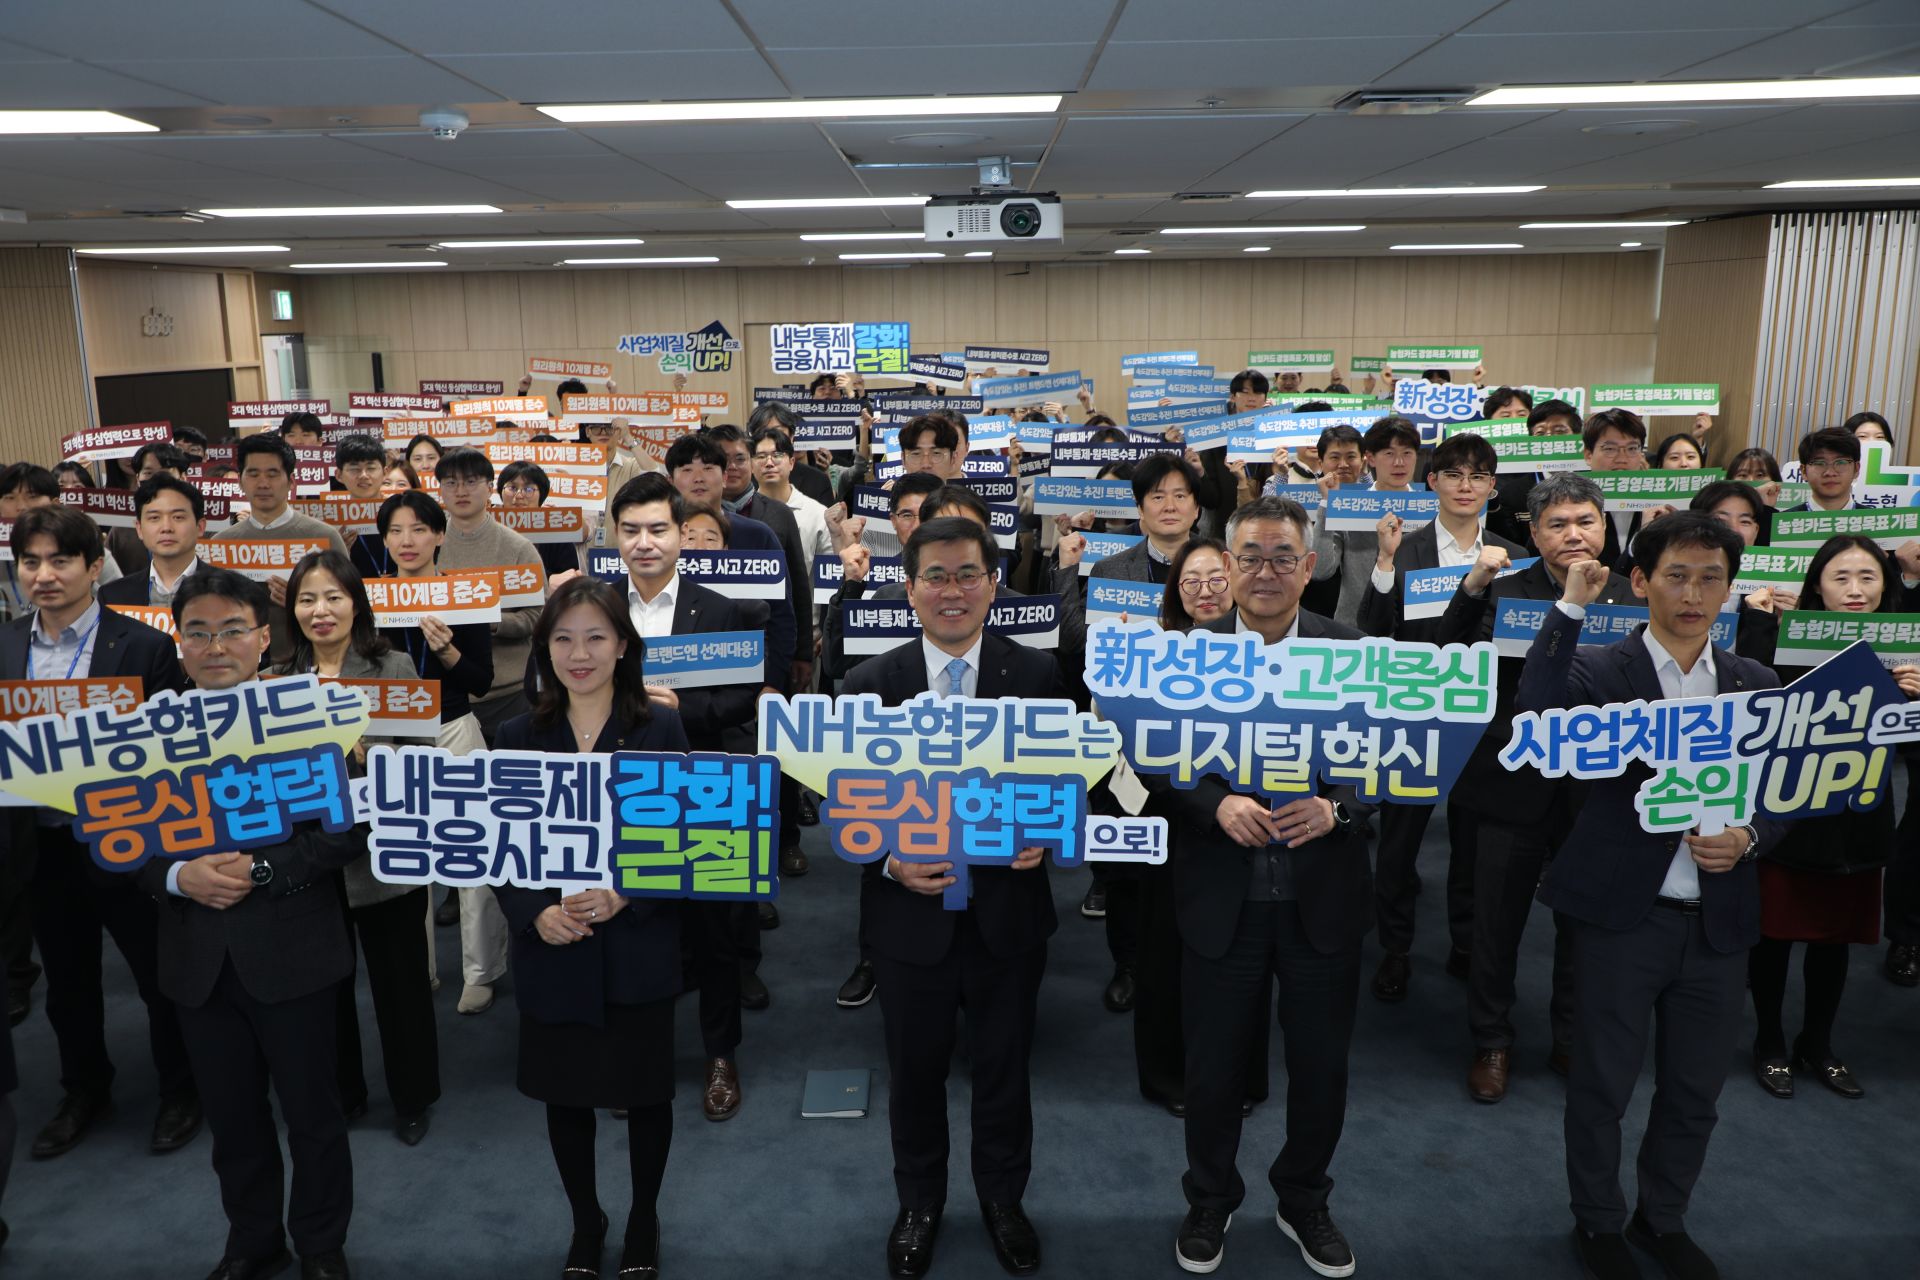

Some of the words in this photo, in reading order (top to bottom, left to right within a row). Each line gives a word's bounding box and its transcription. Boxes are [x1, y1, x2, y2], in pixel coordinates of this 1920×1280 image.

[619, 335, 685, 354] 사업체질
[687, 332, 724, 351] 개선
[773, 327, 850, 349] 내부통제
[855, 324, 908, 349] 강화!
[660, 353, 691, 371] 손익
[694, 351, 730, 371] UP!
[773, 349, 851, 371] 금융사고
[855, 349, 909, 372] 근절!
[1031, 353, 1048, 362] ZERO
[565, 363, 592, 374] 10계명
[592, 364, 609, 376] 준수
[936, 367, 948, 376] 사고
[948, 369, 964, 378] ZERO
[352, 395, 365, 406] 3대
[366, 396, 381, 407] 혁신
[382, 397, 422, 408] 동심협력으로
[423, 398, 440, 408] 완성!
[708, 394, 726, 405] 준수
[1594, 389, 1634, 402] 농협카드
[1634, 388, 1674, 401] 경영목표
[1693, 388, 1715, 401] 달성!
[231, 405, 245, 416] 3대
[246, 404, 261, 416] 혁신
[262, 403, 308, 416] 동심협력으로
[308, 403, 327, 413] 완성!
[454, 400, 492, 416] 원리원칙
[492, 399, 524, 412] 10계명
[525, 398, 545, 411] 준수
[567, 397, 610, 411] 원리원칙
[612, 397, 648, 412] 10계명
[649, 398, 671, 412] 준수
[826, 404, 840, 413] 사고
[841, 403, 862, 413] ZERO
[882, 400, 946, 410] 내부통제·원칙준수로
[946, 400, 961, 410] 사고
[961, 400, 981, 410] ZERO
[678, 408, 698, 420] 준수
[387, 421, 429, 436] 원리원칙
[429, 419, 468, 435] 10계명
[469, 419, 493, 434] 준수
[816, 426, 832, 436] 사고
[832, 425, 853, 436] ZERO
[1020, 427, 1053, 439] 속도감있는
[1187, 424, 1221, 438] 속도감있는
[1221, 420, 1237, 431] 추진!
[1258, 418, 1298, 434] 속도감있는
[1299, 417, 1318, 430] 추진!
[84, 427, 142, 449] 동심협력으로
[143, 426, 168, 441] 완성!
[489, 444, 536, 462] 원리원칙
[537, 445, 577, 462] 10계명
[579, 447, 603, 463] 준수
[1054, 448, 1137, 461] 내부통제·원칙준수로
[1530, 440, 1577, 456] 경영목표
[300, 467, 325, 481] 완성!
[961, 462, 977, 473] 사고
[978, 461, 1004, 473] ZERO
[576, 479, 603, 497] 준수
[985, 483, 1013, 496] ZERO
[1038, 483, 1083, 499] 속도감있는
[1083, 485, 1105, 499] 추진!
[1617, 476, 1669, 492] 경영목표
[1668, 475, 1691, 493] 기필
[87, 493, 105, 508] 3대
[106, 495, 126, 512] 혁신
[1332, 497, 1381, 512] 속도감있는
[1382, 498, 1406, 513] 추진!
[549, 510, 578, 528] 준수
[990, 513, 1013, 527] ERO
[1777, 516, 1833, 535] 농협카드
[1834, 514, 1891, 533] 경영목표
[231, 543, 286, 565] 10계명
[715, 559, 742, 575] 사고
[743, 559, 780, 576] ZERO
[503, 568, 537, 590] 준수
[389, 581, 449, 608] 10계명
[453, 579, 493, 605] 준수
[1093, 586, 1151, 606] 속도감있는
[988, 608, 1015, 627] 사고
[1017, 604, 1055, 624] ZERO
[1787, 619, 1859, 641] 농협카드
[700, 640, 758, 661] 선제대응!
[0, 686, 81, 714] 10계명
[85, 682, 136, 711] 준수
[386, 686, 433, 713] 준수
[0, 680, 364, 781] NH농협카드는
[765, 698, 1116, 767] NH농협카드는
[1507, 701, 1735, 772] 사업체질
[1135, 718, 1314, 793] 디지털
[1320, 720, 1441, 798] 혁신
[374, 753, 601, 824] 내부통제
[614, 759, 773, 829] 강화!
[1643, 762, 1750, 827] 손익
[1766, 746, 1889, 815] UP!
[82, 752, 345, 864] 동심협력
[828, 776, 1078, 860] 동심협력
[374, 816, 603, 882] 금융사고
[616, 825, 773, 895] 근절!
